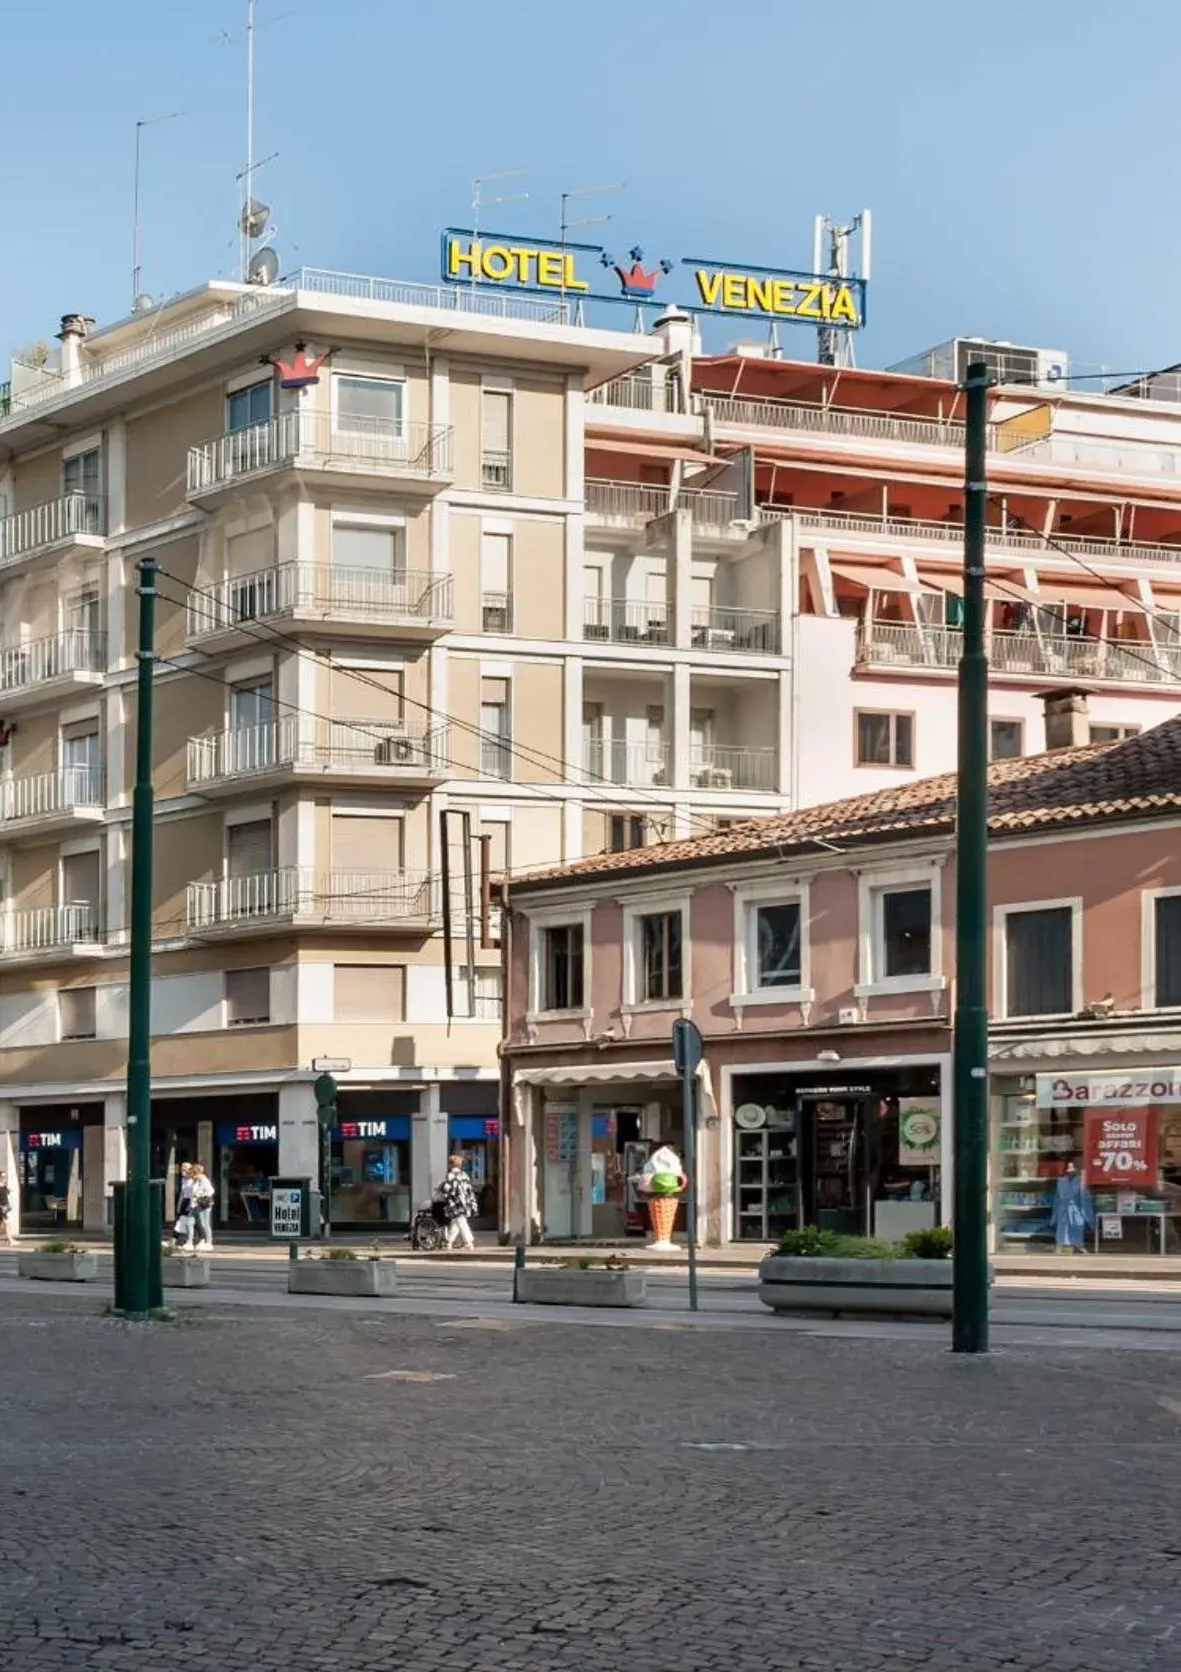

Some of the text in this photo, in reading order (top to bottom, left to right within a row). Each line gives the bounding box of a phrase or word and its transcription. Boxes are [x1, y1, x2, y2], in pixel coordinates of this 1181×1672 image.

[449, 240, 857, 322] HOTEL VENEZIA
[250, 1125, 276, 1140] TIM
[357, 1121, 387, 1136] TIM
[40, 1132, 61, 1147] TIM
